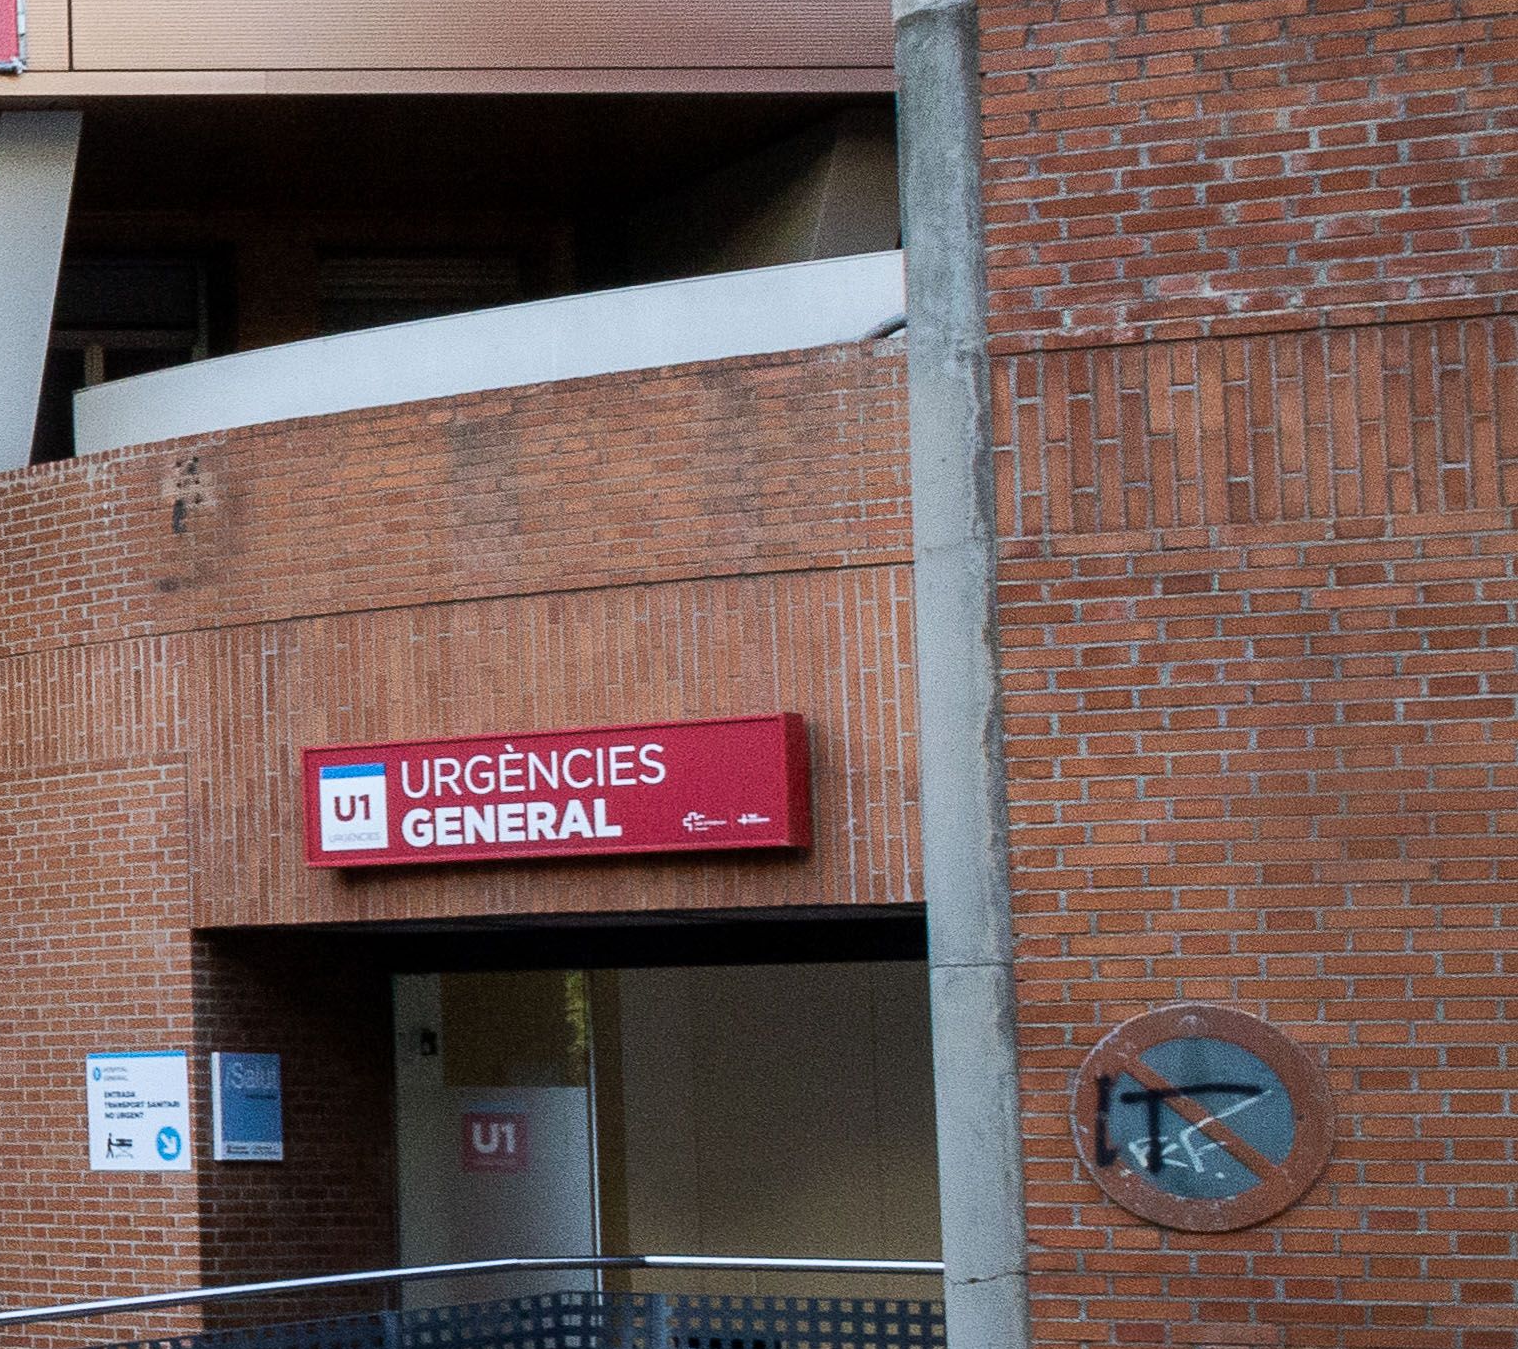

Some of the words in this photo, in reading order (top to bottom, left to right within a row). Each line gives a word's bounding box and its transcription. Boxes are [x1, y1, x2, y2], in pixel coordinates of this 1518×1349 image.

[400, 743, 666, 799] URGÈNCIES
[334, 793, 371, 824] U1
[401, 798, 622, 848] GENERAL
[472, 1122, 516, 1154] U1
